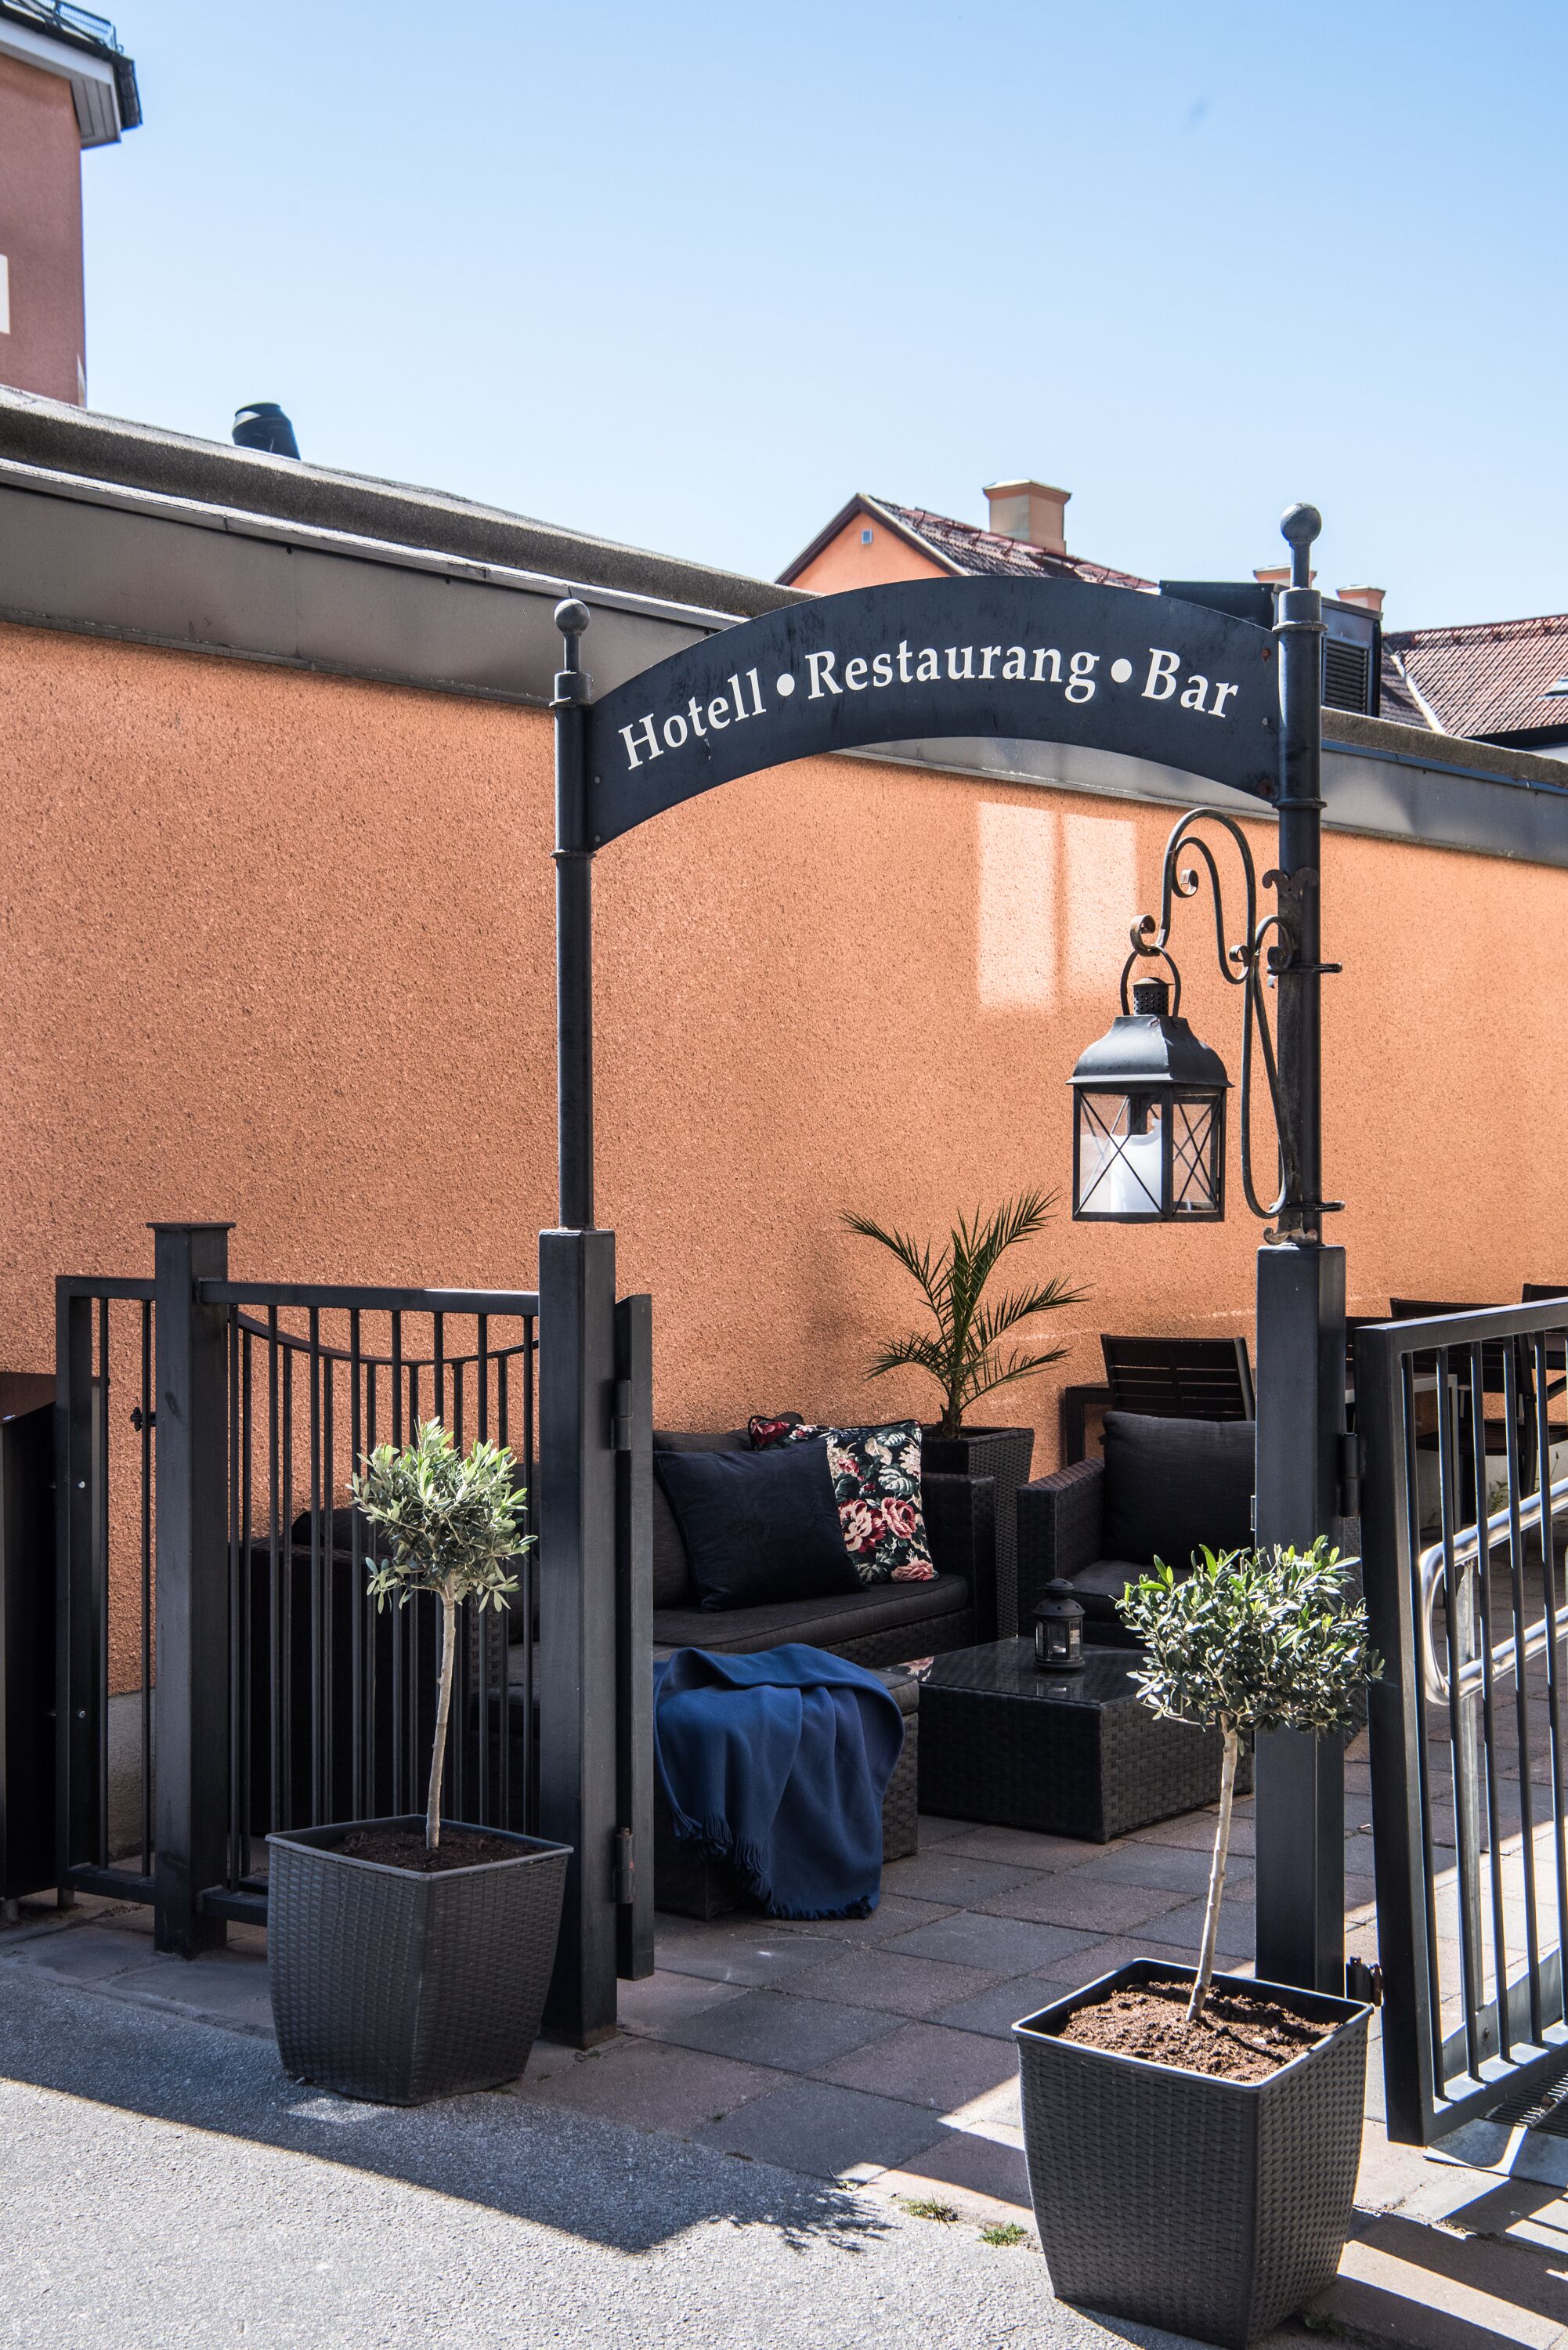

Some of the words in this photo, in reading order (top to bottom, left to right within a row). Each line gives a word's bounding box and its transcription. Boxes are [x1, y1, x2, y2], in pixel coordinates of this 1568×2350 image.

[618, 667, 767, 771] Hotell
[804, 639, 1100, 703] Restaurang
[1140, 647, 1239, 718] Bar
